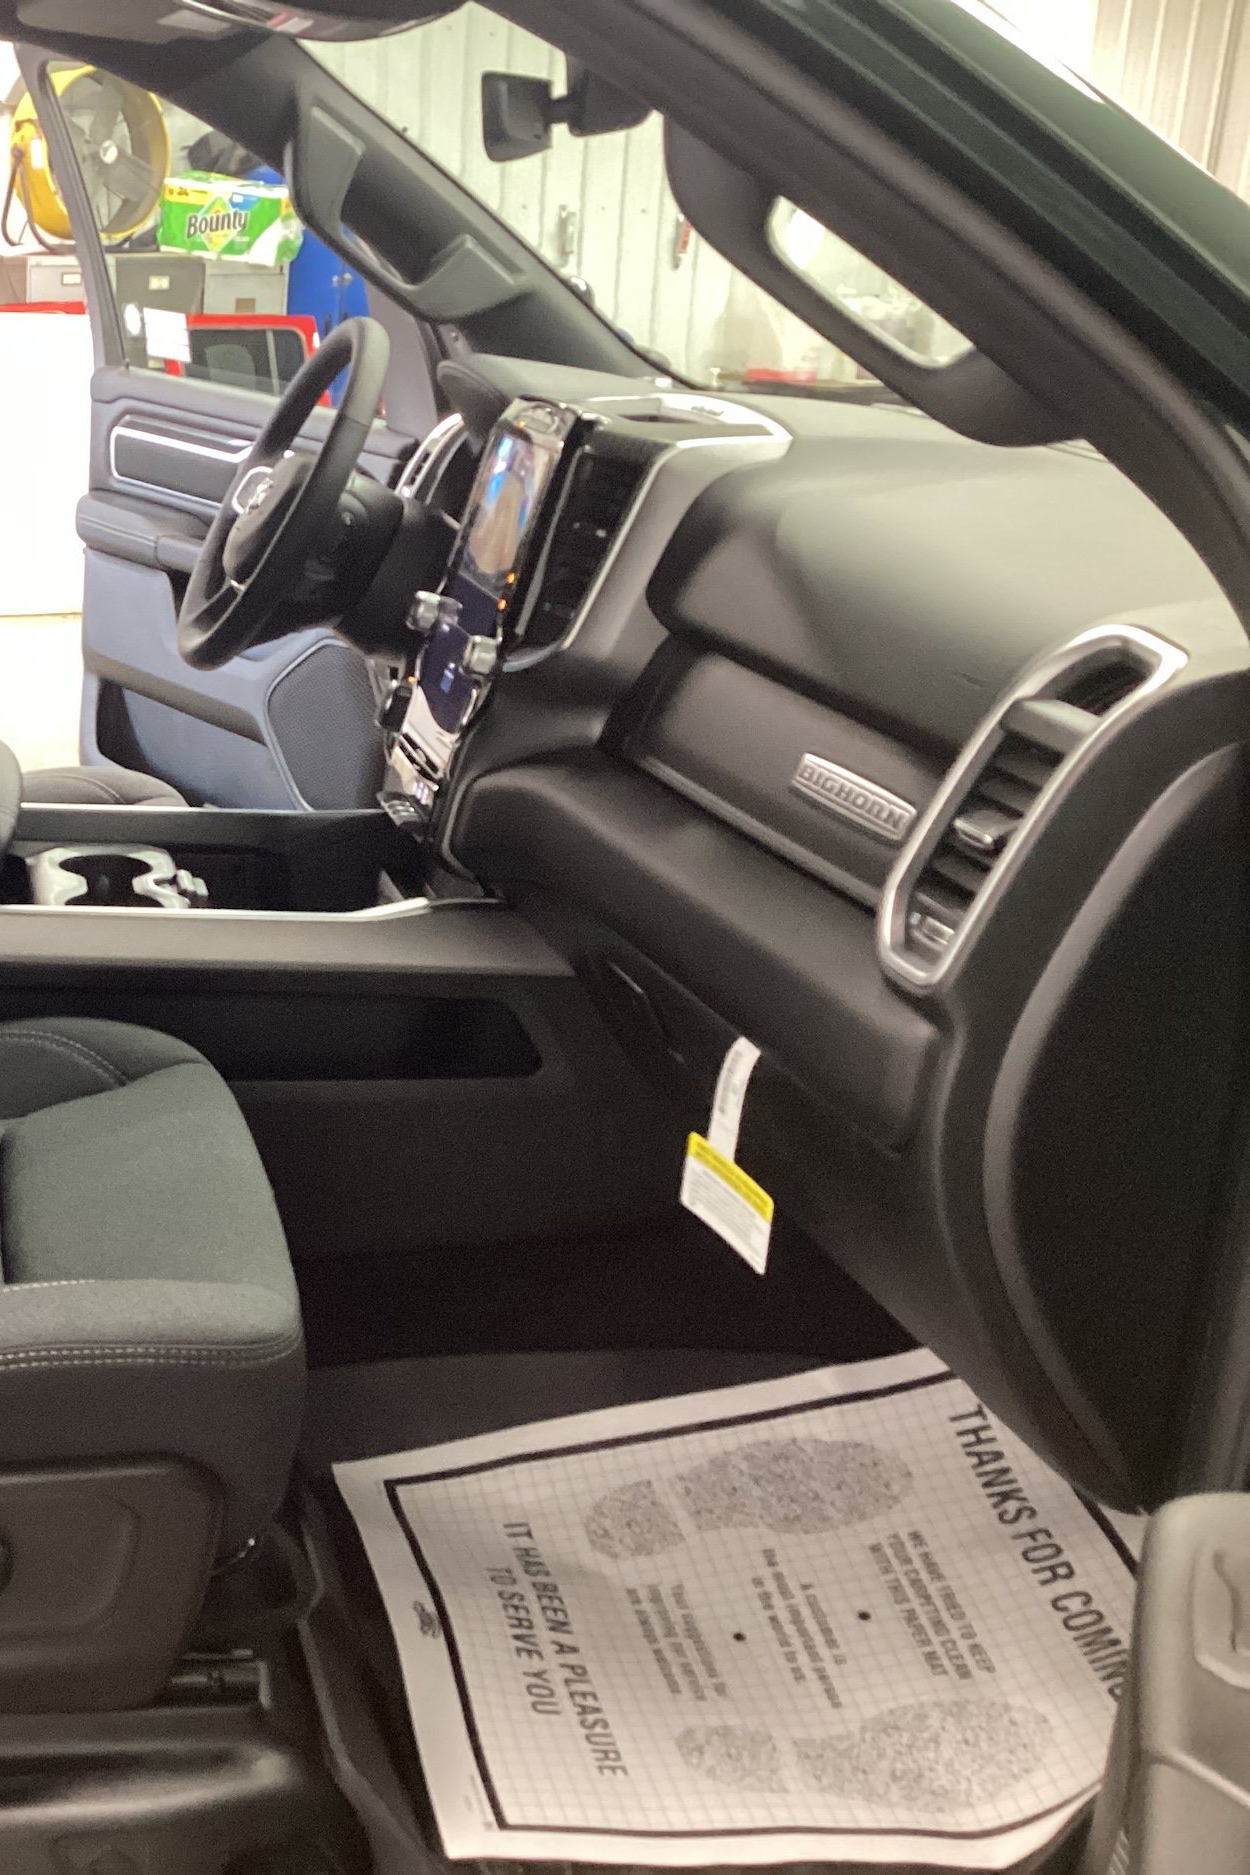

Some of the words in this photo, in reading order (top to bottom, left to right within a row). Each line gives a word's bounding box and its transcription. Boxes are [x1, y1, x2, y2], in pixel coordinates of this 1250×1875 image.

[187, 210, 249, 239] Bounty
[950, 1403, 1038, 1525] THANKS
[1011, 1527, 1075, 1586] FOR
[503, 1522, 534, 1540] IT
[486, 1567, 517, 1586] TO
[514, 1547, 551, 1578] HAS
[498, 1590, 545, 1661] SERVE
[532, 1581, 574, 1635] BEEN
[551, 1639, 580, 1655] A
[522, 1669, 562, 1716] YOU
[559, 1662, 628, 1777] PLEASURE
